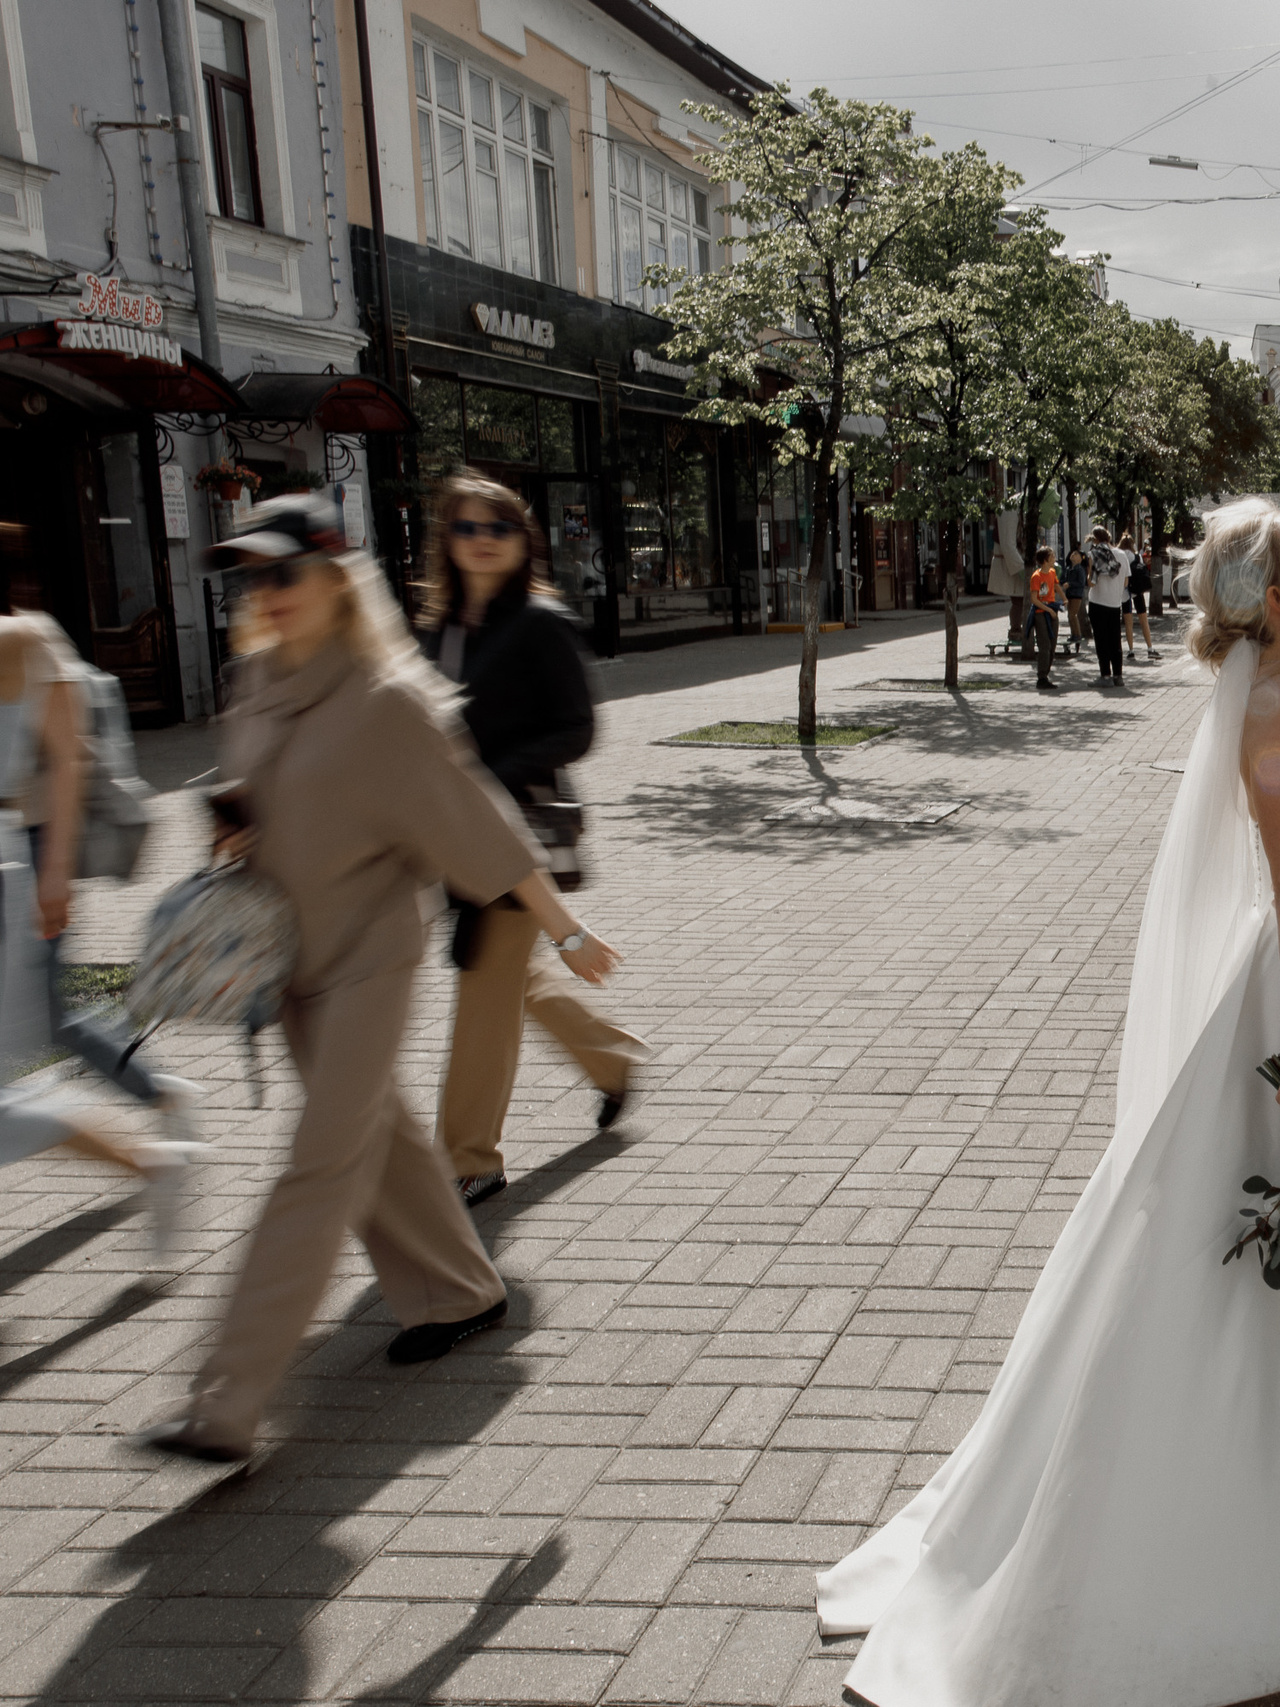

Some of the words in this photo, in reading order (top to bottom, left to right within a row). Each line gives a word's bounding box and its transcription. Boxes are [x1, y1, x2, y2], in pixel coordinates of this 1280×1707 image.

[77, 273, 164, 328] Мир
[63, 320, 183, 367] ЖЕНЩИНЫ
[486, 306, 556, 350] АЛМАЗ
